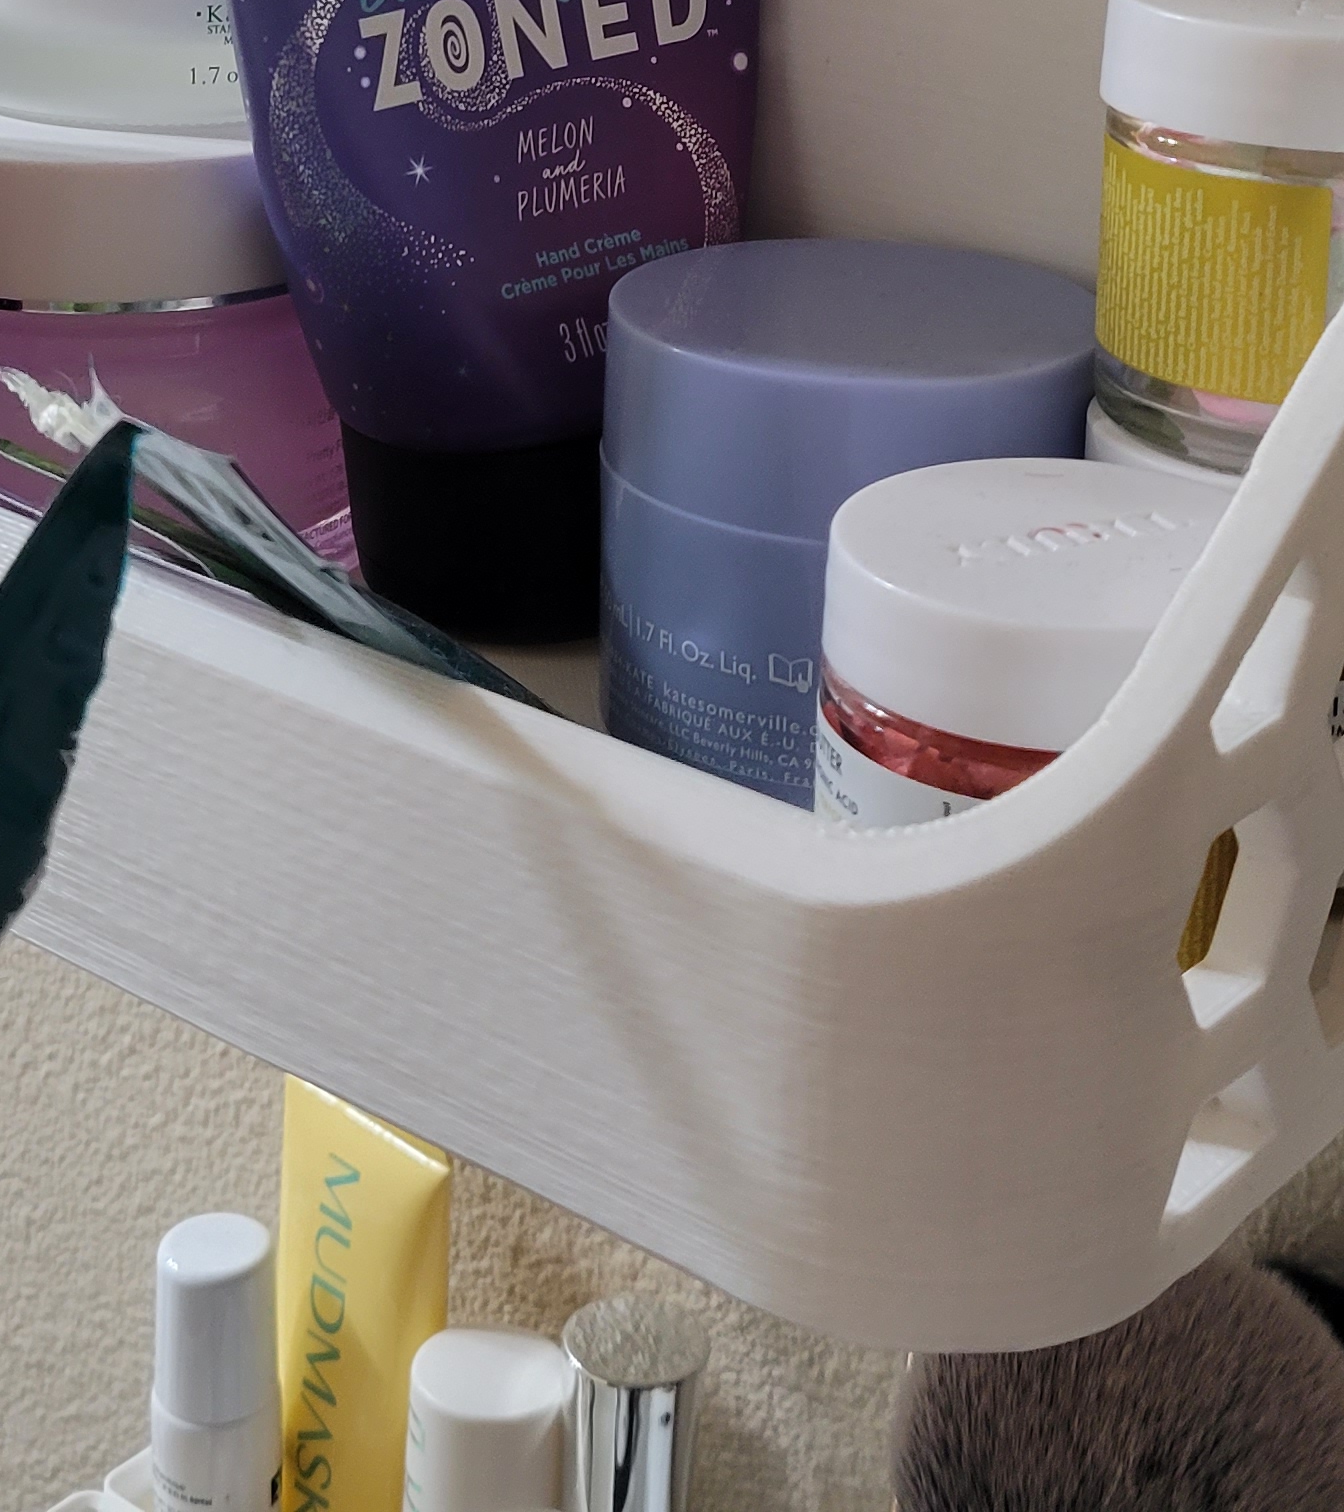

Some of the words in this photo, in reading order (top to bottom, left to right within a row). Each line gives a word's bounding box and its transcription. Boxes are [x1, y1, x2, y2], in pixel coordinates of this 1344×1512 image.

[191, 66, 221, 85] 1.7
[516, 115, 595, 164] MELON
[541, 149, 587, 180] and
[516, 164, 627, 222] PLUMERIA
[535, 242, 581, 268] Hand
[584, 228, 642, 255] Crème
[501, 273, 558, 300] Crème
[561, 262, 602, 284] Pour
[606, 252, 637, 271] Les
[639, 238, 690, 262] Mains
[559, 322, 577, 363] 3
[659, 628, 678, 656] Fl.
[681, 639, 715, 670] Oz.
[719, 650, 758, 685] Liq.
[692, 731, 737, 758] Beverly
[777, 753, 800, 769] CA
[718, 724, 753, 743] AUX
